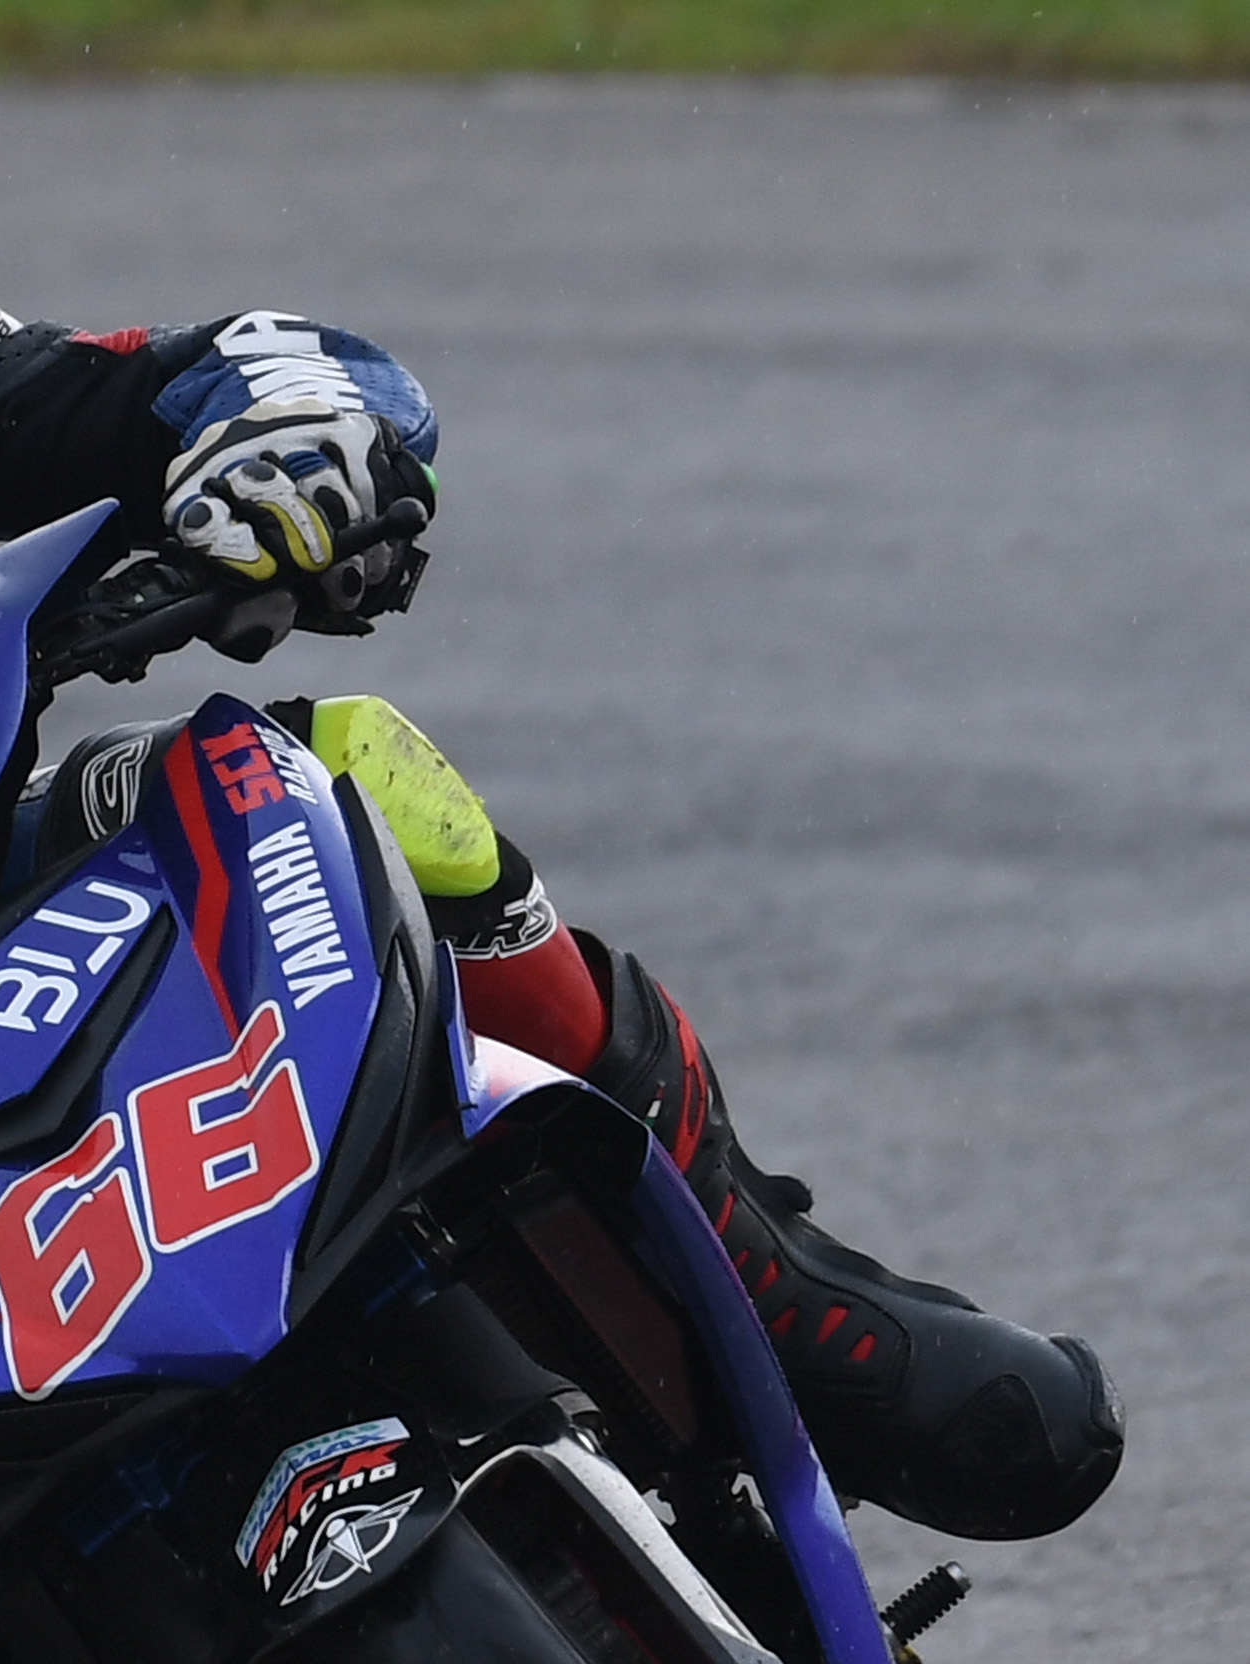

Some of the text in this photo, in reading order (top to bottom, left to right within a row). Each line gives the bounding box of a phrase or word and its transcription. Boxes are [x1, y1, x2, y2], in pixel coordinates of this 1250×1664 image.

[200, 722, 286, 816] SCK
[247, 820, 354, 1011] YAMAHA
[262, 1460, 398, 1593] RACING
